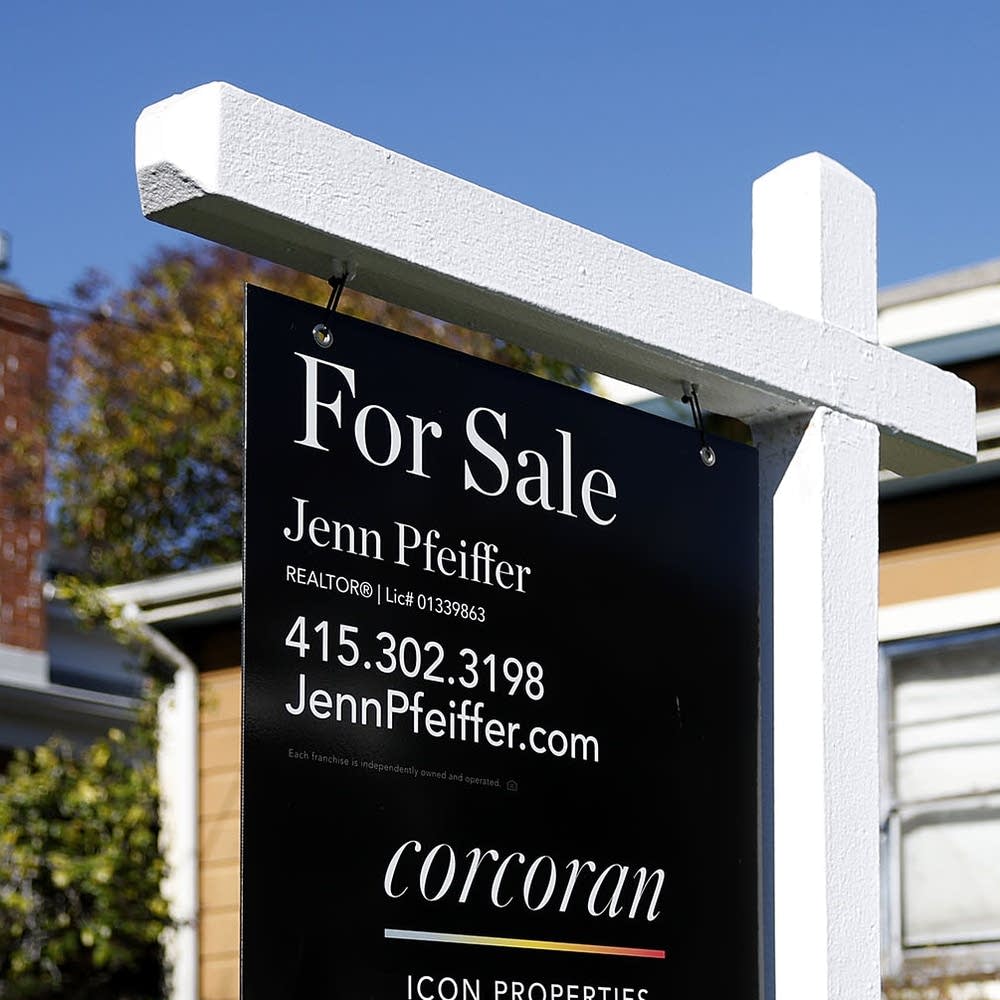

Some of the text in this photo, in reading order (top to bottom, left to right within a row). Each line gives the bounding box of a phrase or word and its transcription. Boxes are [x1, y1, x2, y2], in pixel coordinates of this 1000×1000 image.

[294, 352, 616, 525] For Sale
[283, 497, 531, 593] Jenn Pfeiffer
[386, 587, 414, 608] Lic#
[417, 594, 486, 623] 01339863
[285, 616, 545, 700] 415.302.3198
[285, 674, 600, 762] JennPfeiffer.com
[288, 748, 309, 760] Each
[311, 752, 349, 766] franchise
[352, 759, 358, 767] is
[361, 761, 418, 777] independently
[421, 769, 447, 780] owned
[449, 772, 463, 782] and
[384, 840, 665, 921] corcoran
